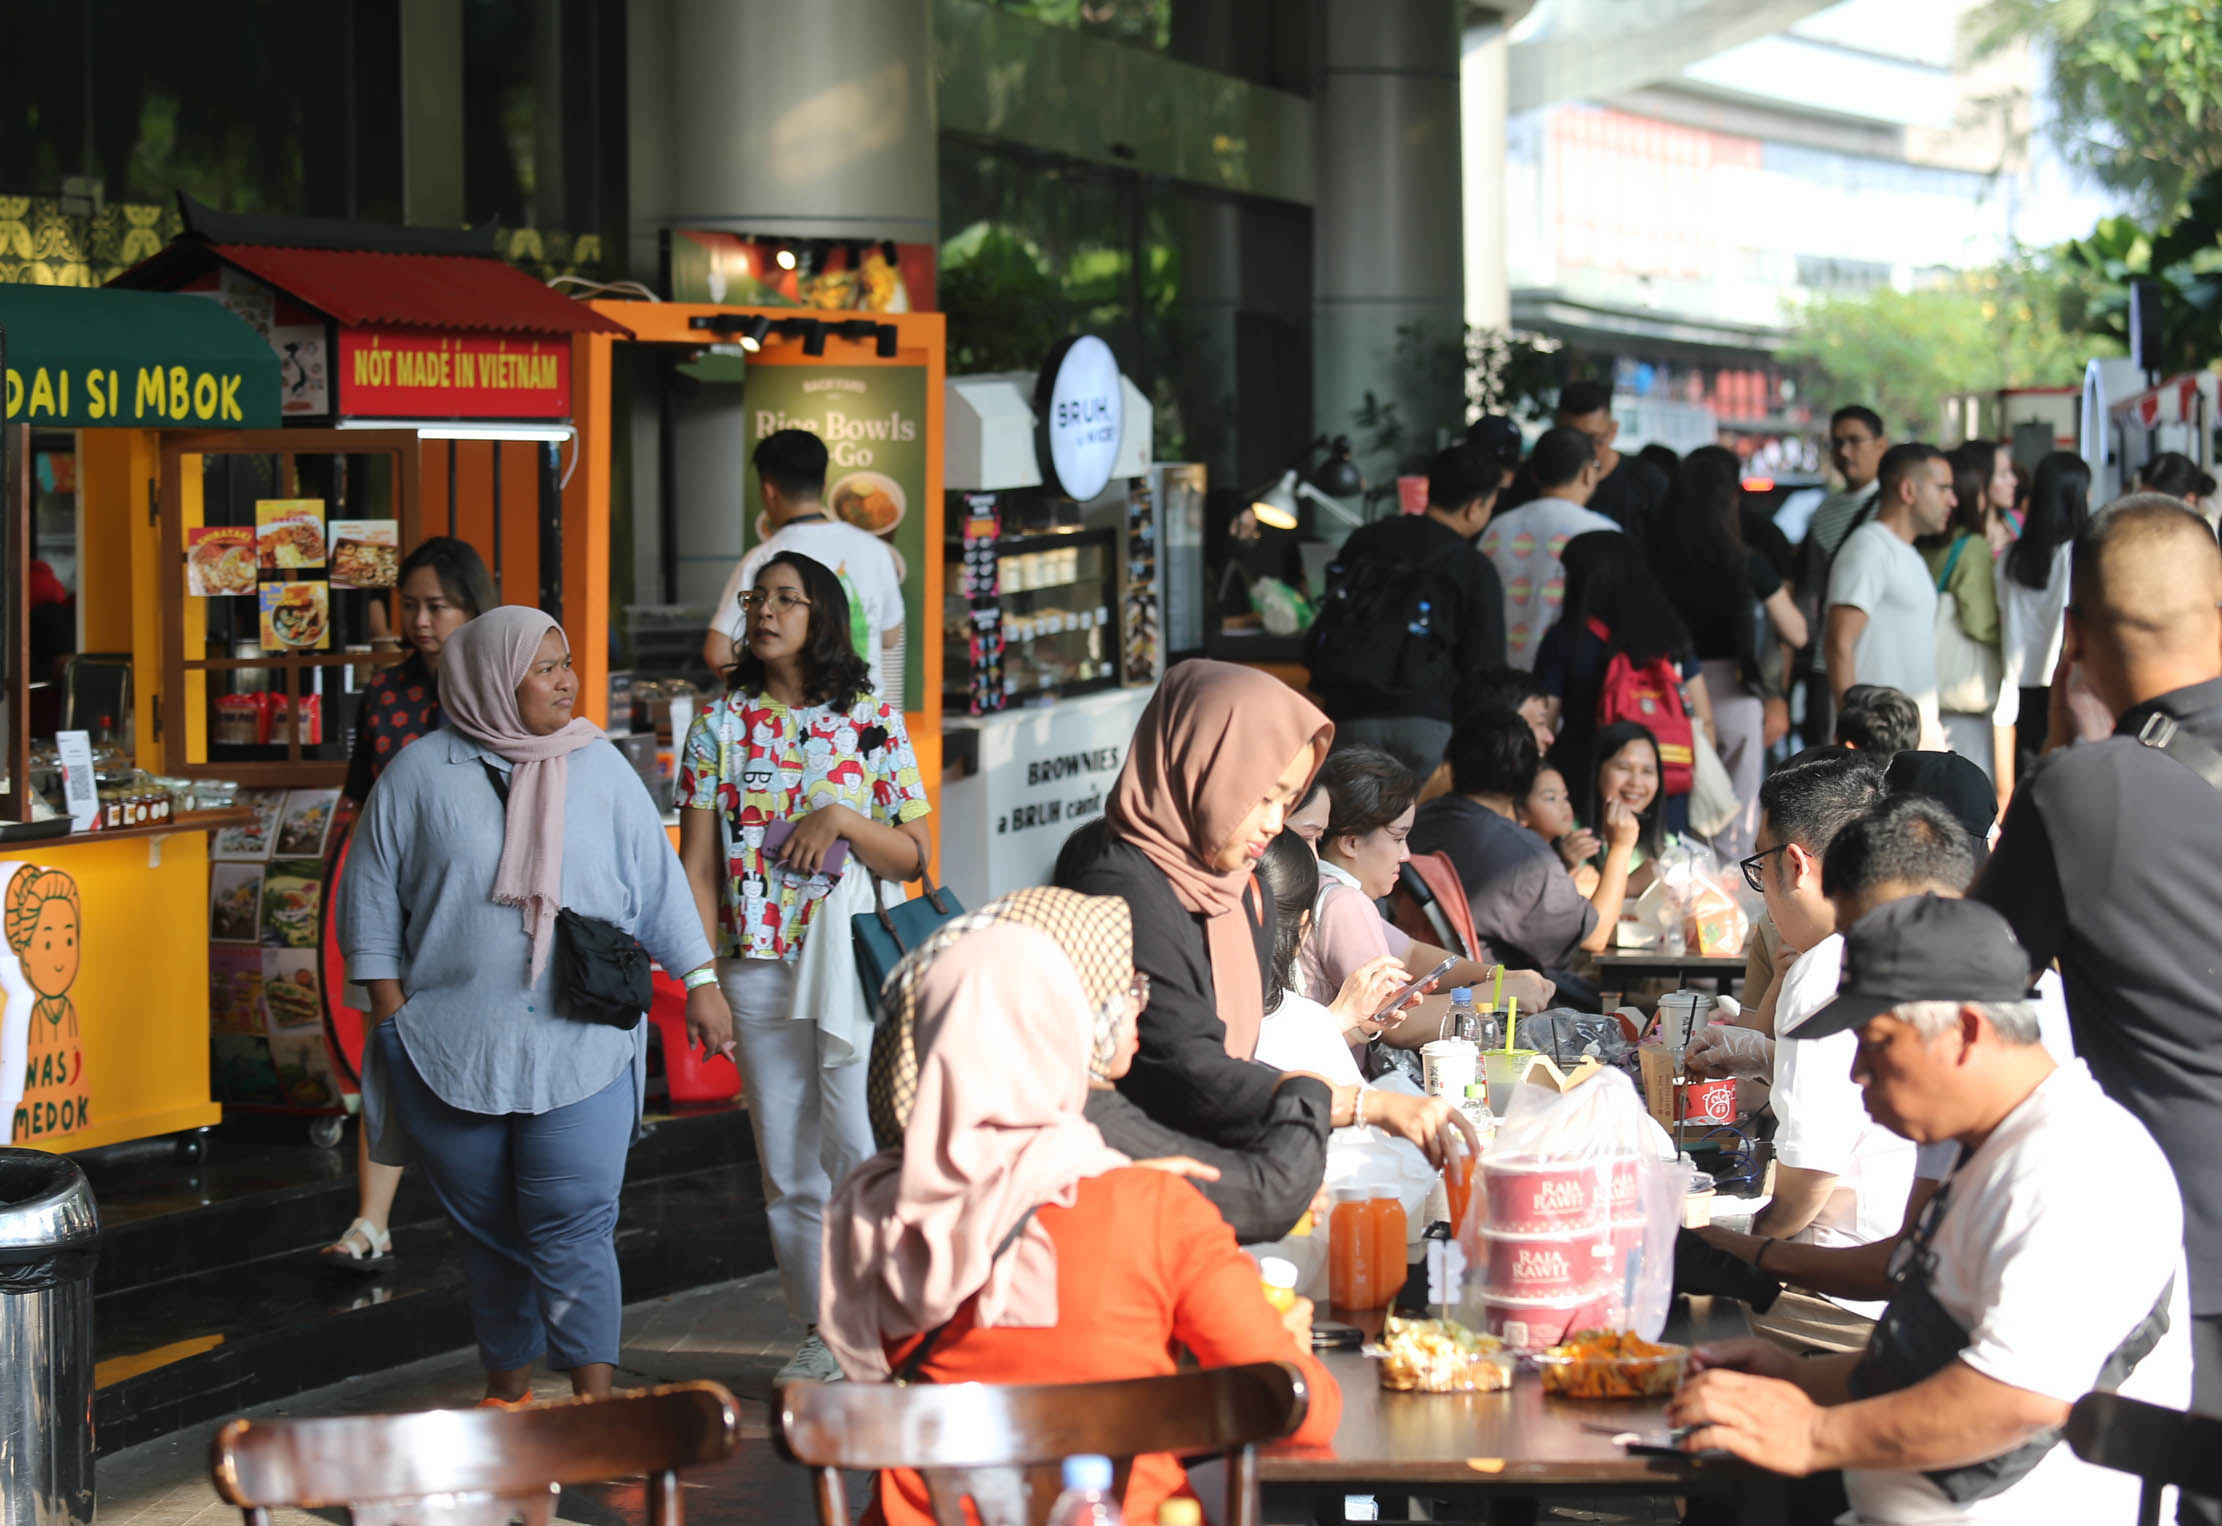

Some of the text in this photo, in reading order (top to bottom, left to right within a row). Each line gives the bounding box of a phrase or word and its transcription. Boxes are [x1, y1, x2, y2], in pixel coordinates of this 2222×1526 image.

[86, 368, 118, 418] SI
[135, 365, 243, 421] MBOK
[825, 410, 917, 442] Bowls
[1027, 747, 1119, 786] BROWNIES
[1012, 801, 1061, 832] BRUH
[12, 1095, 88, 1141] MEDOK
[1533, 1193, 1584, 1209] RAWIT
[1541, 1180, 1580, 1195] RAJA
[1513, 1262, 1569, 1278] RAWIT
[1518, 1249, 1563, 1265] RAJA
